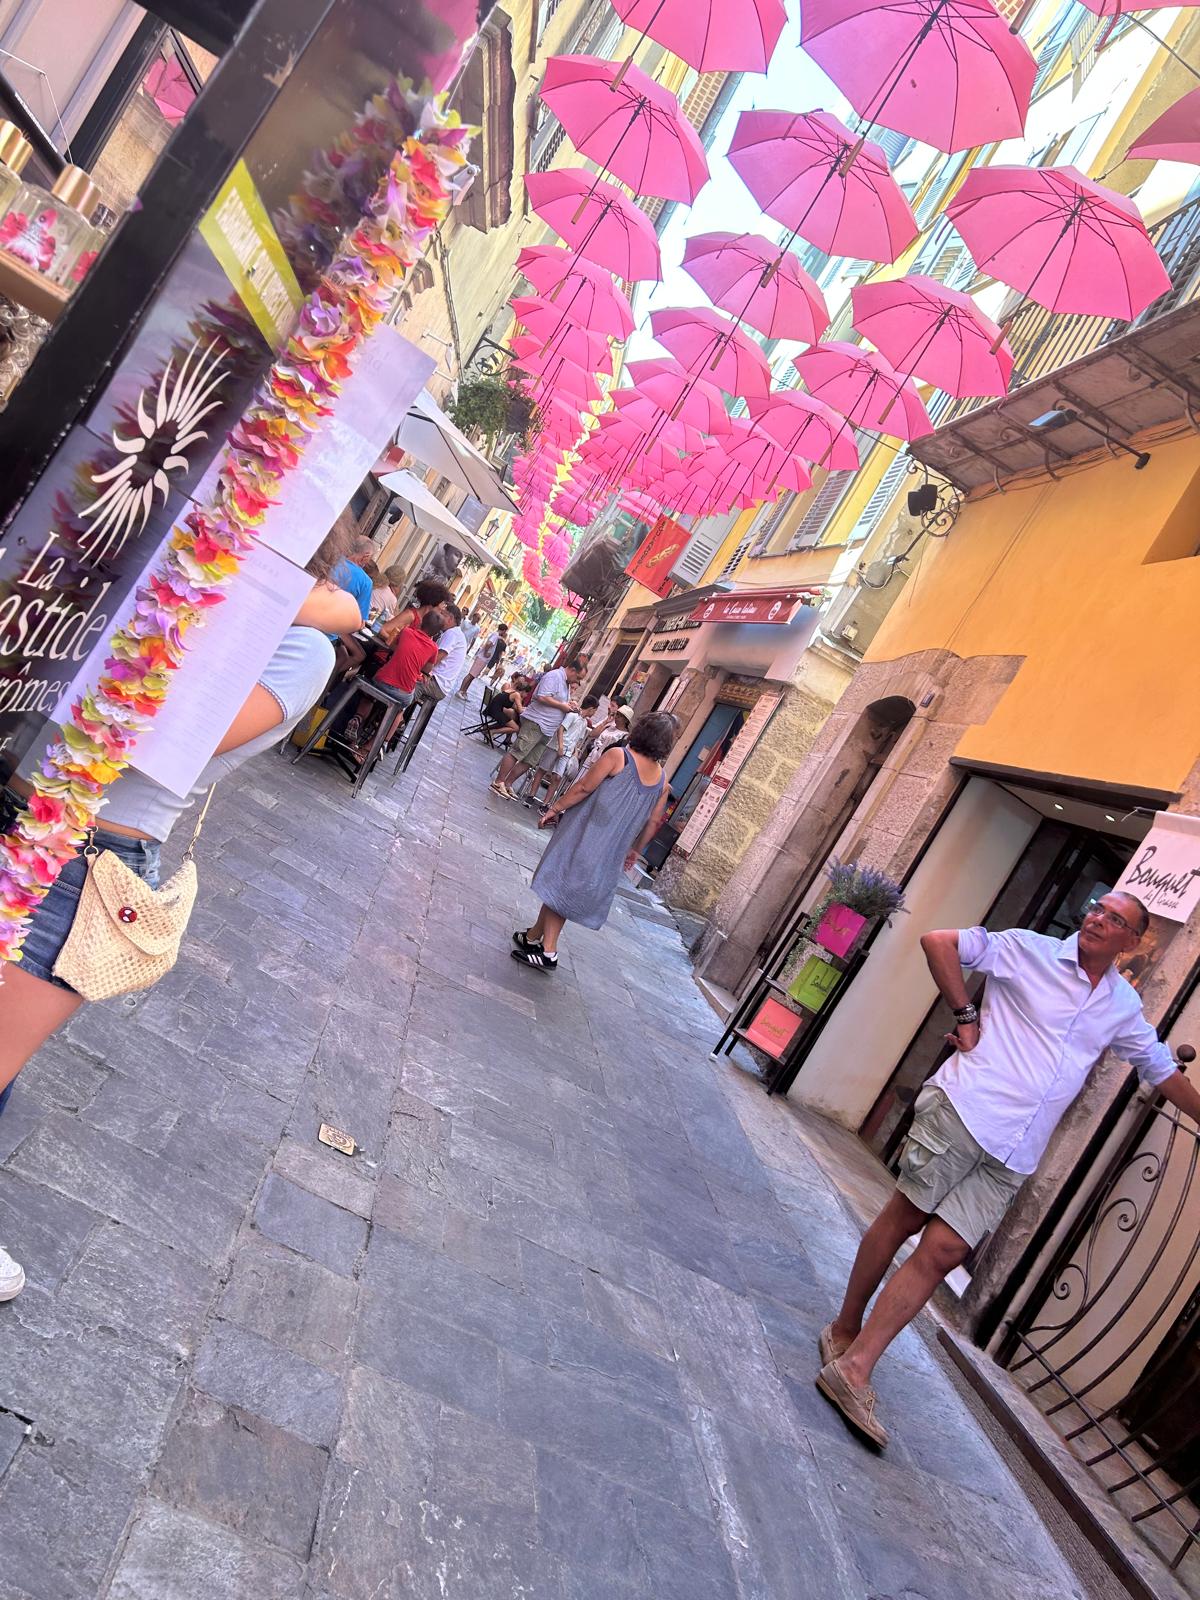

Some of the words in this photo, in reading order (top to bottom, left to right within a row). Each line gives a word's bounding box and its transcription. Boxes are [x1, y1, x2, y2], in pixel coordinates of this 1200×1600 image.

[17, 531, 66, 591] La
[0, 580, 112, 662] astide
[1125, 845, 1200, 907] Bouquet
